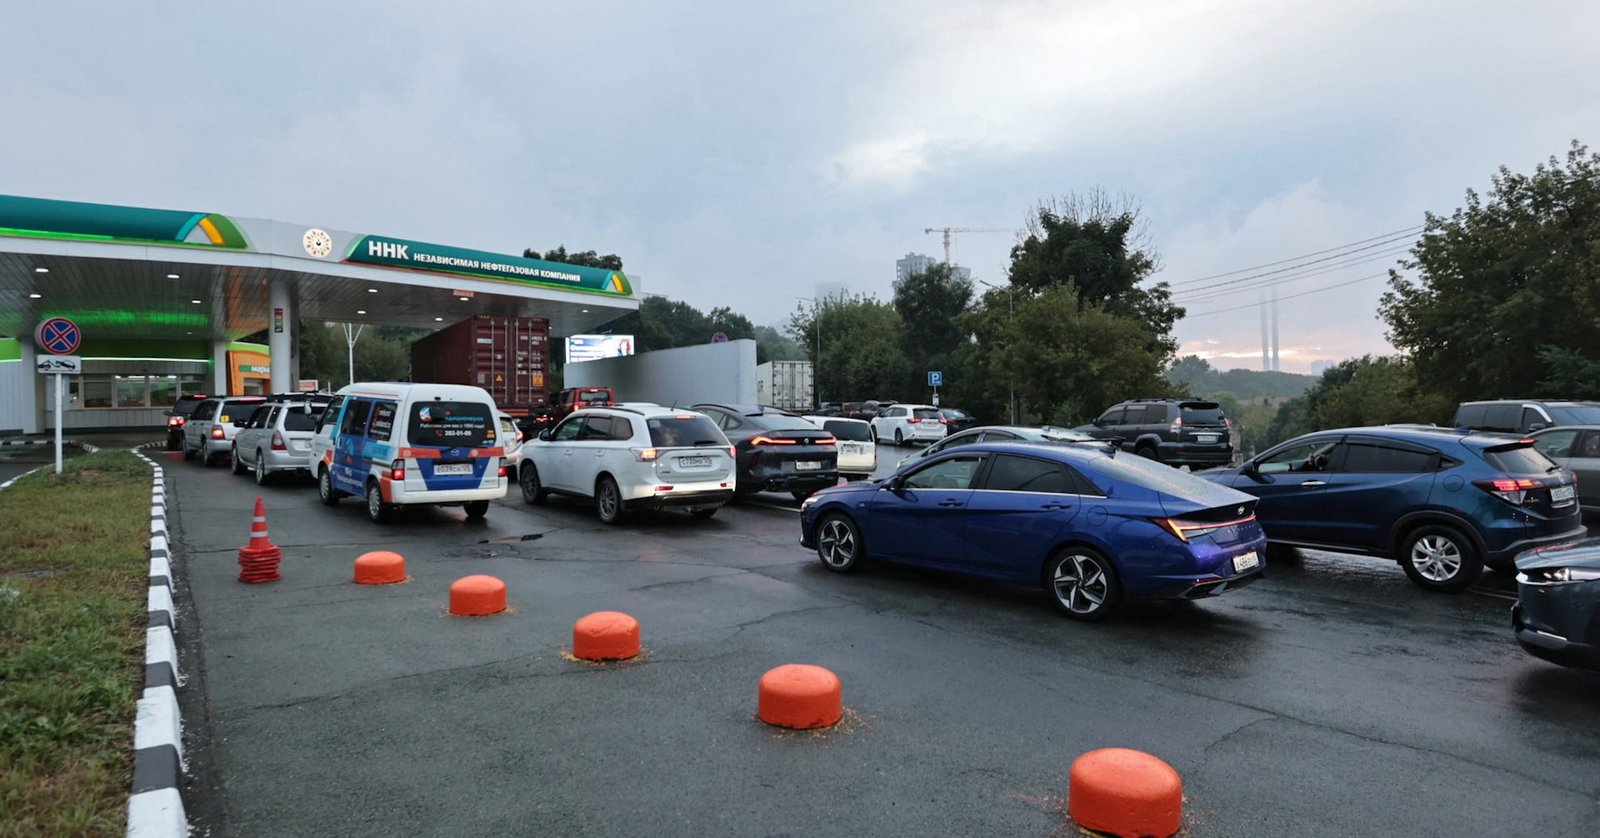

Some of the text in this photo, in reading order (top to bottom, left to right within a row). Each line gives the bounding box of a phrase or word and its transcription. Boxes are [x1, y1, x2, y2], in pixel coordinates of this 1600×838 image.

[368, 240, 581, 283] ННК НЕЗАВИСИМАЯ НЕФТЕГАЗОВАЯ КОМПАНИЯ
